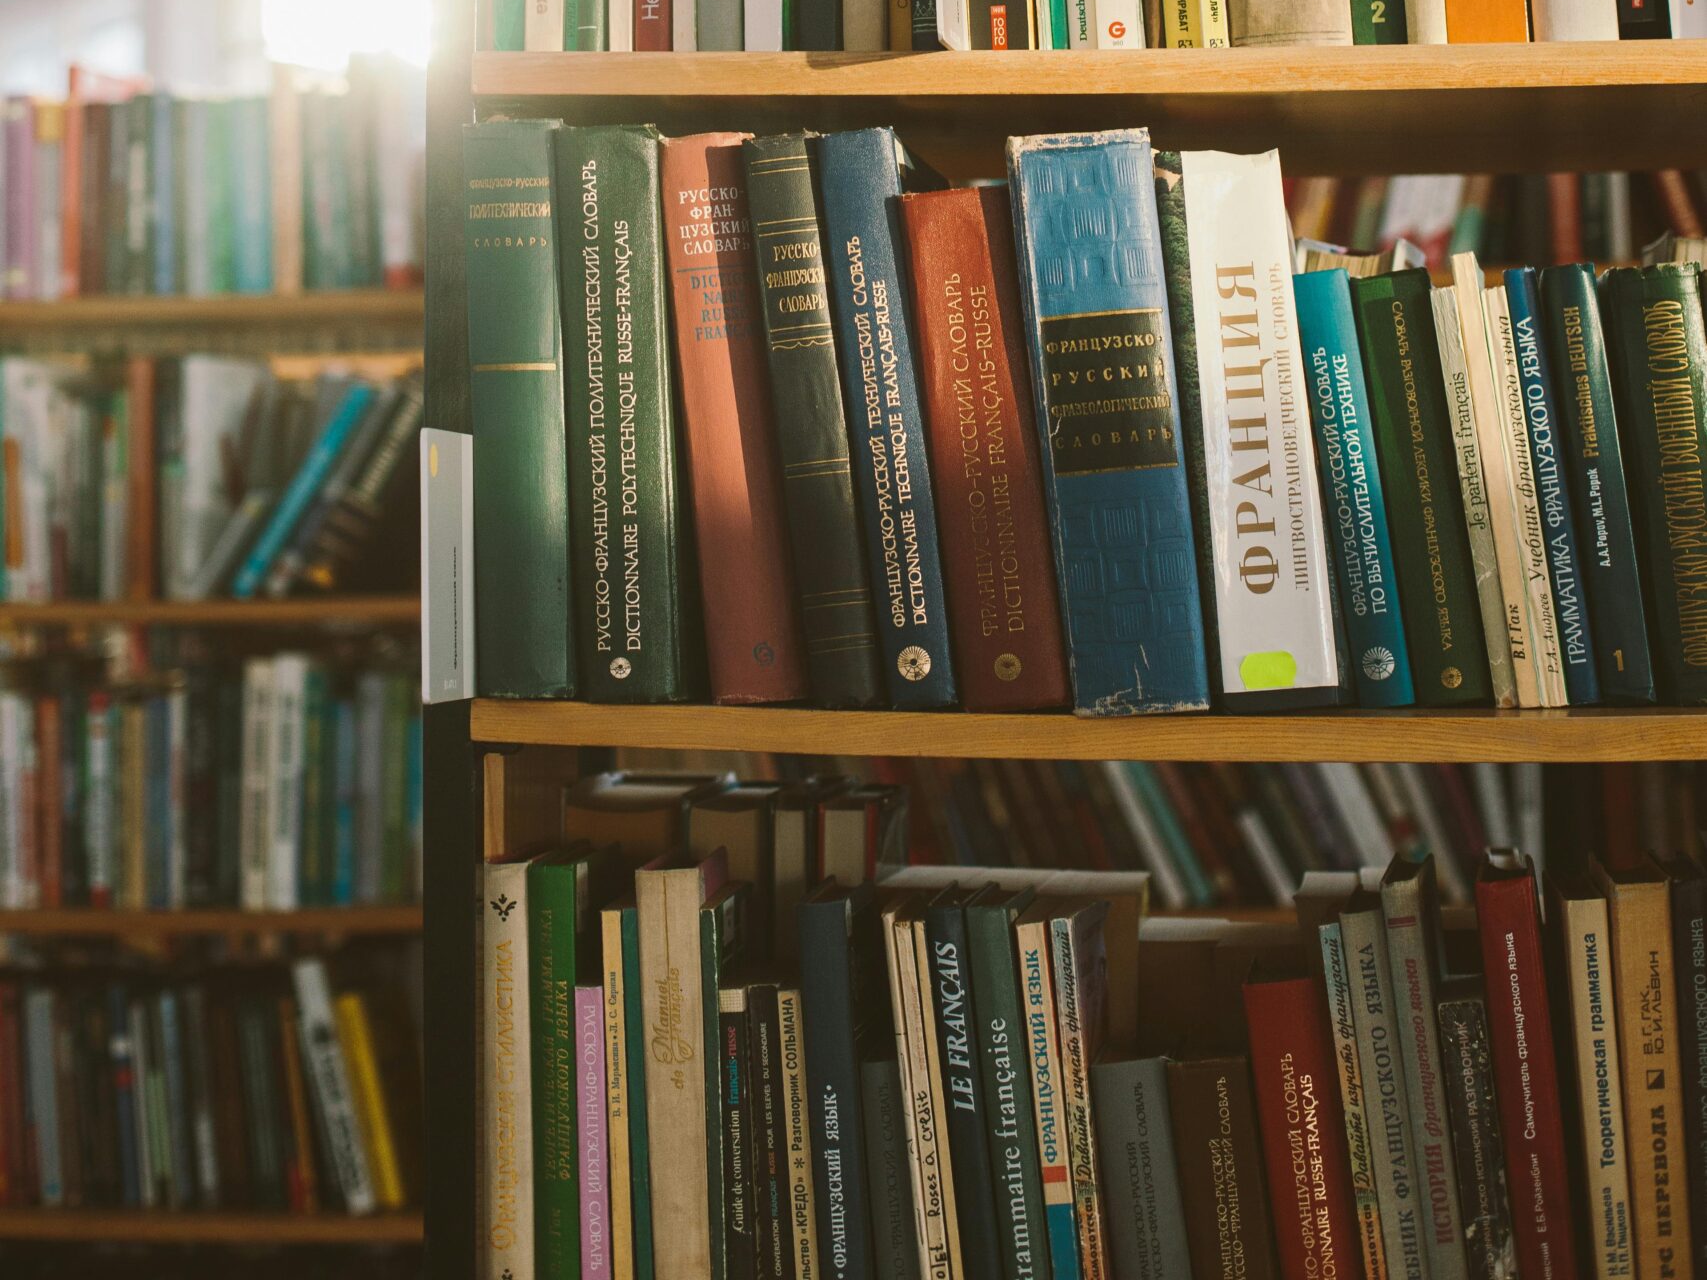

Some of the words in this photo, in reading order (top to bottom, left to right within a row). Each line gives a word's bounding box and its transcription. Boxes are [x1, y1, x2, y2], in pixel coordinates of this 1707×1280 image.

[1075, 0, 1087, 40] Deutsch
[1370, 0, 1386, 24] 2
[470, 201, 551, 219] ПОЛИТЕХНИЧЕСКИЙ
[582, 160, 598, 238] СЛОВАРЬ
[679, 186, 744, 204] РУССКО-
[680, 218, 751, 239] ЦУЗСКИЙ
[690, 203, 735, 219] ФРАН-
[474, 236, 547, 248] СЛОВАРЬ
[684, 238, 750, 255] СЛОВАРЬ
[773, 241, 821, 262] РУССКО-
[847, 236, 867, 306] СЛОВАРЬ
[613, 219, 636, 363] RUSSE-FRANÇAIS
[779, 293, 825, 313] СЛОВАРЬ
[944, 272, 968, 372] СЛОВАРЬ
[1269, 261, 1287, 341] СЛОВАРЬ
[583, 245, 604, 427] ПОЛИТЕХНИЧЕСКИЙ
[854, 312, 881, 428] ТЕХНИЧЕСКИЙ
[872, 279, 900, 406] FRANÇAIS-RUSSE
[973, 284, 1004, 465] FRANÇAIS-RUSSE
[1046, 333, 1162, 354] ФРАНЦУЗСКО-
[1052, 357, 1164, 386] РУССКИЙ
[1498, 315, 1514, 367] языка
[1516, 316, 1540, 379] ЯЗЫКА
[1563, 305, 1587, 372] DEUTSCH
[1051, 390, 1170, 417] ФРАЗЕОЛОГИЧЕСКИЙ
[1312, 346, 1335, 419] СЛОВАРЬ
[1333, 353, 1356, 427] ТЕХНИКЕ
[1449, 371, 1472, 438] français
[1576, 375, 1598, 457] Praktisches
[618, 371, 639, 515] POLYTECHNIQUE
[888, 413, 911, 502] TECHNIQUE
[1055, 428, 1172, 449] СЛОВАРЬ
[1217, 259, 1277, 596] ФРАНЦИЯ
[1507, 373, 1536, 499] французского
[1527, 383, 1562, 528] ФРАНЦУЗСКОГО
[955, 377, 997, 636] ФРАНЦУЗСКО-РУССКИЙ
[1276, 347, 1308, 592] ЛИНГВОСТРАНОВЕДЧЕСКИЙ
[1344, 430, 1381, 584] ВЫЧИСЛИТЕЛЬНОЙ
[1391, 300, 1408, 355] СЛОВАРЬ
[1400, 358, 1423, 442] РАЗГОВОРНОЙ
[1413, 446, 1431, 502] ЛЕКСИКИ
[1423, 505, 1445, 603] ФРАНЦУЗСКОГО
[1437, 606, 1452, 650] ЯЗЫКА
[1458, 444, 1485, 506] parlerai
[589, 435, 612, 651] РУССКО-ФРАНЦУЗСКИЙ
[870, 435, 904, 627] ФРАНЦУЗСКО-РУССКИЙ
[992, 472, 1024, 631] DICTIONNAIRE
[1323, 422, 1366, 616] ФРАНЦУЗСКО-РУССКИЙ
[1468, 511, 1486, 530] Je
[1524, 503, 1545, 583] Учебник
[622, 523, 642, 650] DICTIONNAIRE
[900, 509, 926, 625] DICTIONNAIRE
[1370, 586, 1386, 613] ПО
[1552, 534, 1585, 664] ГРАММАТИКА
[1539, 592, 1554, 644] Андреев
[539, 908, 554, 1022] ГРАММАТИКА
[1025, 948, 1042, 1005] ЯЗЫК
[1057, 931, 1079, 1032] французский
[1325, 938, 1354, 1040] французский
[1359, 942, 1383, 1016] ЯЗЫКА
[1403, 957, 1422, 1012] языка
[1505, 932, 1516, 970] языка
[1584, 933, 1604, 1032] грамматика
[555, 979, 568, 1038] ЯЗЫКА
[935, 939, 969, 1070] FRANÇAIS
[1510, 972, 1527, 1059] французского
[581, 1004, 602, 1192] РУССКО-ФРАНЦУЗСКИЙ
[950, 1073, 975, 1113] LE
[1029, 1011, 1057, 1163] ФРАНЦУЗСКИЙ
[1066, 1037, 1084, 1100] изучать
[1340, 1043, 1360, 1107] изучать
[1413, 1016, 1442, 1137] французского
[1520, 1062, 1535, 1140] Самоучитель
[1593, 1039, 1614, 1169] Теоретическая
[541, 1037, 557, 1181] ТЕОРЕТИЧЕСКАЯ
[556, 1047, 570, 1180] ФРАНЦУЗСКОГО
[823, 1092, 838, 1139] ЯЗЫК
[1073, 1105, 1091, 1180] Давайте
[1371, 1024, 1409, 1199] ФРАНЦУЗСКОГО
[1349, 1112, 1370, 1187] Давайте
[824, 1148, 846, 1268] ФРАНЦУЗСКИЙ
[1423, 1143, 1454, 1245] ИСТОРИЯ
[587, 1200, 603, 1270] СЛОВАРЬ
